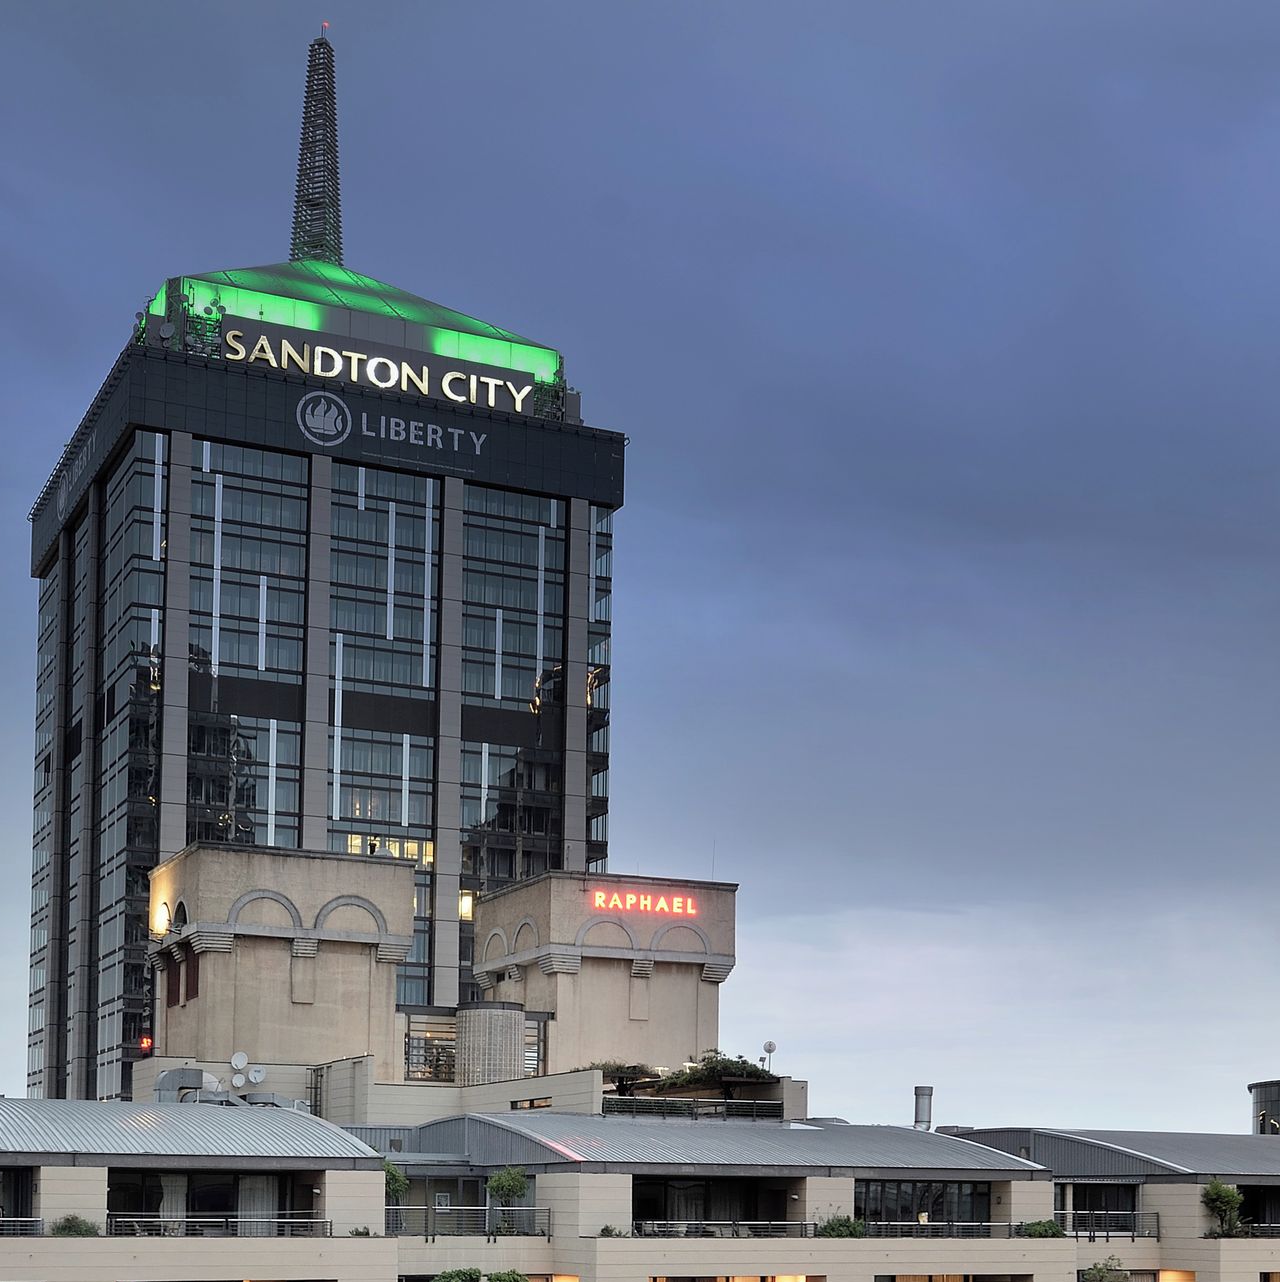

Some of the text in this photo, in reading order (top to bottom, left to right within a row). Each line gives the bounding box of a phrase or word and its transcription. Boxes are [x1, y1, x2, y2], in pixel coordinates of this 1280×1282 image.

[224, 330, 533, 413] SANDTON CITY
[361, 412, 488, 455] LIBERTY
[594, 891, 697, 914] RAPHAEL
